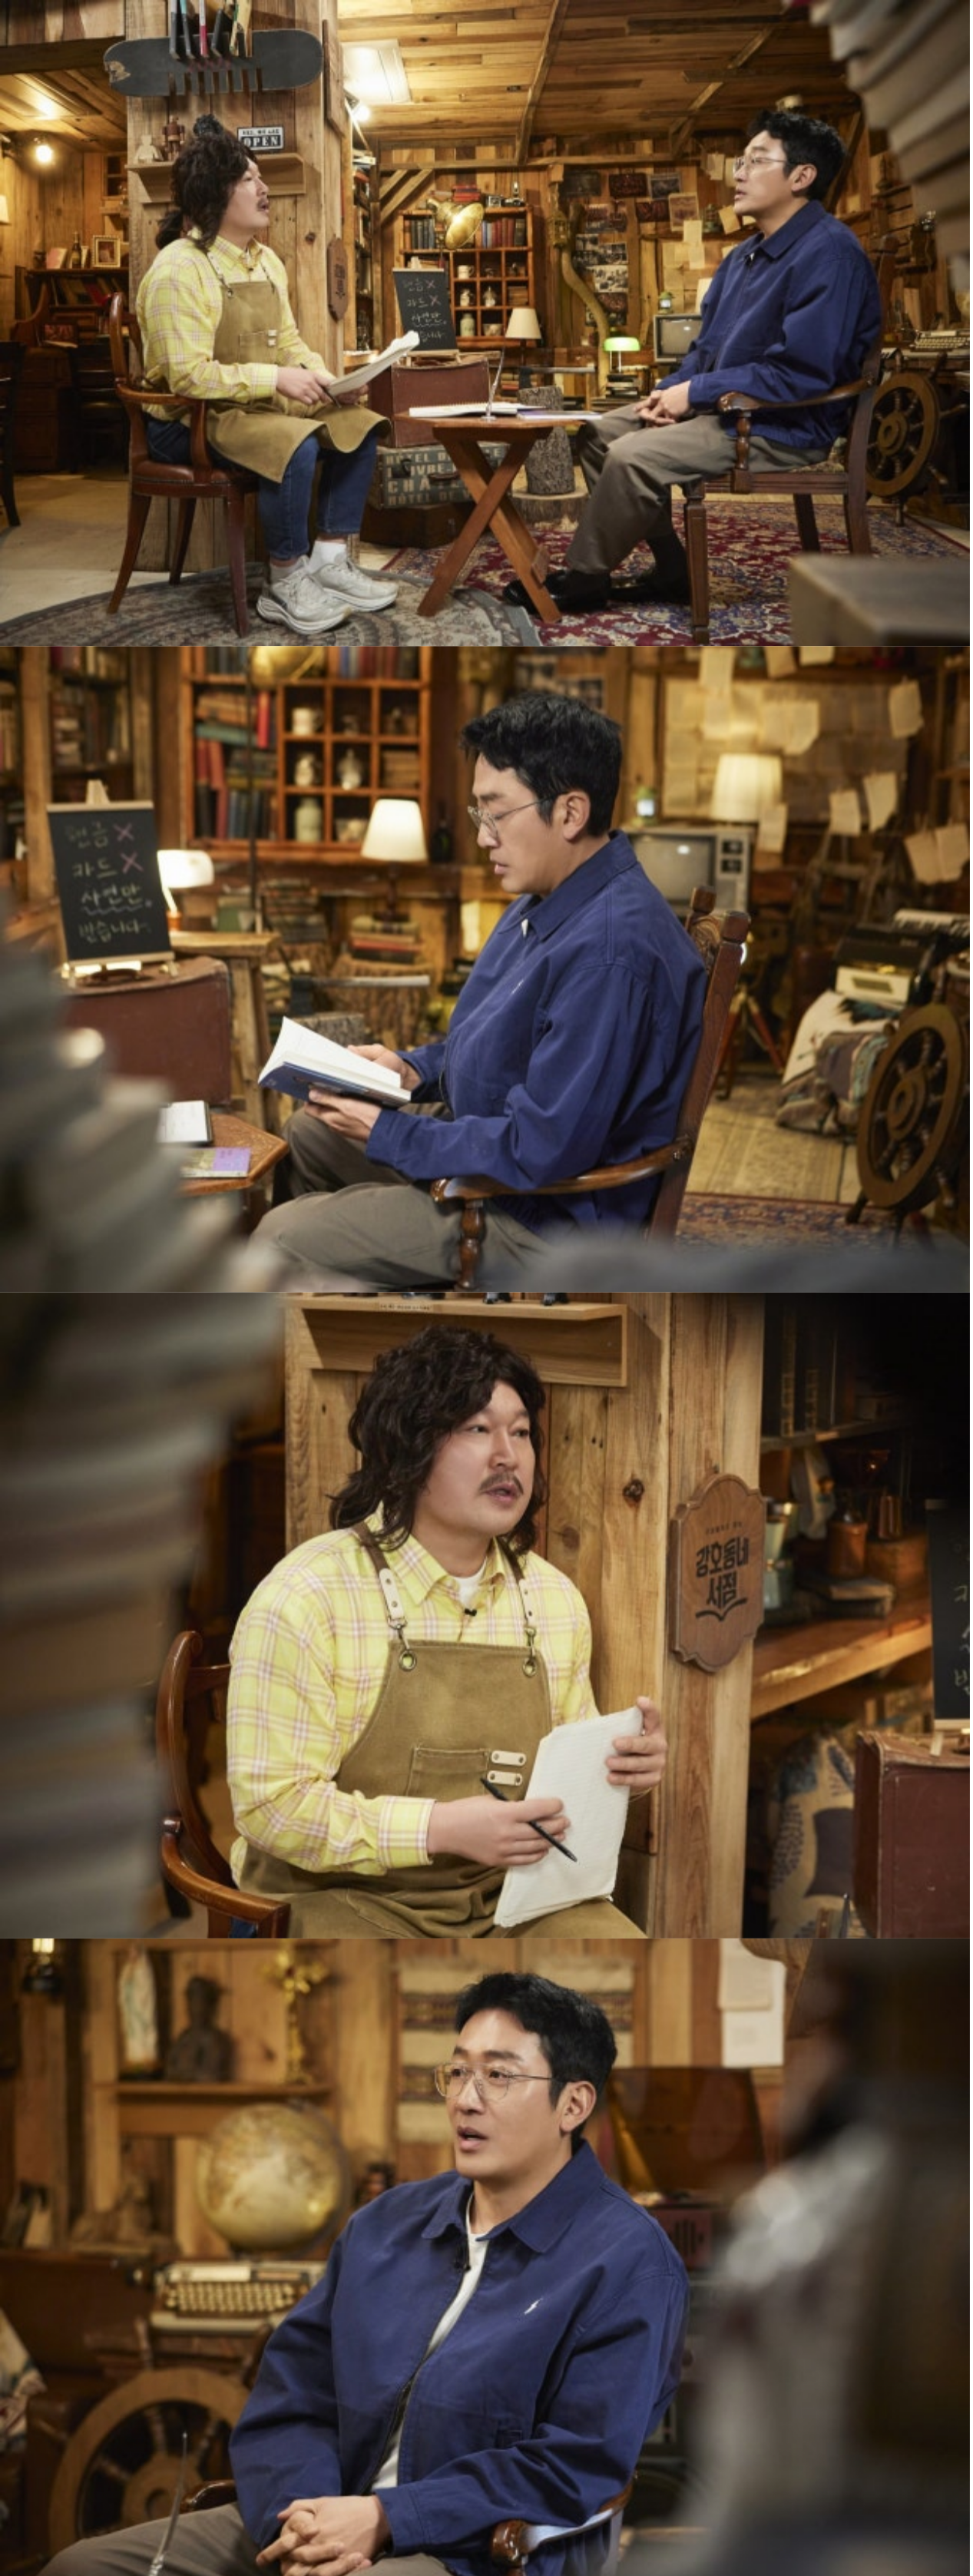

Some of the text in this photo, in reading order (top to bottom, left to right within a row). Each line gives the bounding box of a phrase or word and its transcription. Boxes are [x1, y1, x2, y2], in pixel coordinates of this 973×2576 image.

[243, 136, 279, 147] OPEN
[72, 857, 117, 879] 카드
[696, 1537, 750, 1578] 강호동네
[707, 1571, 737, 1609] 서점
